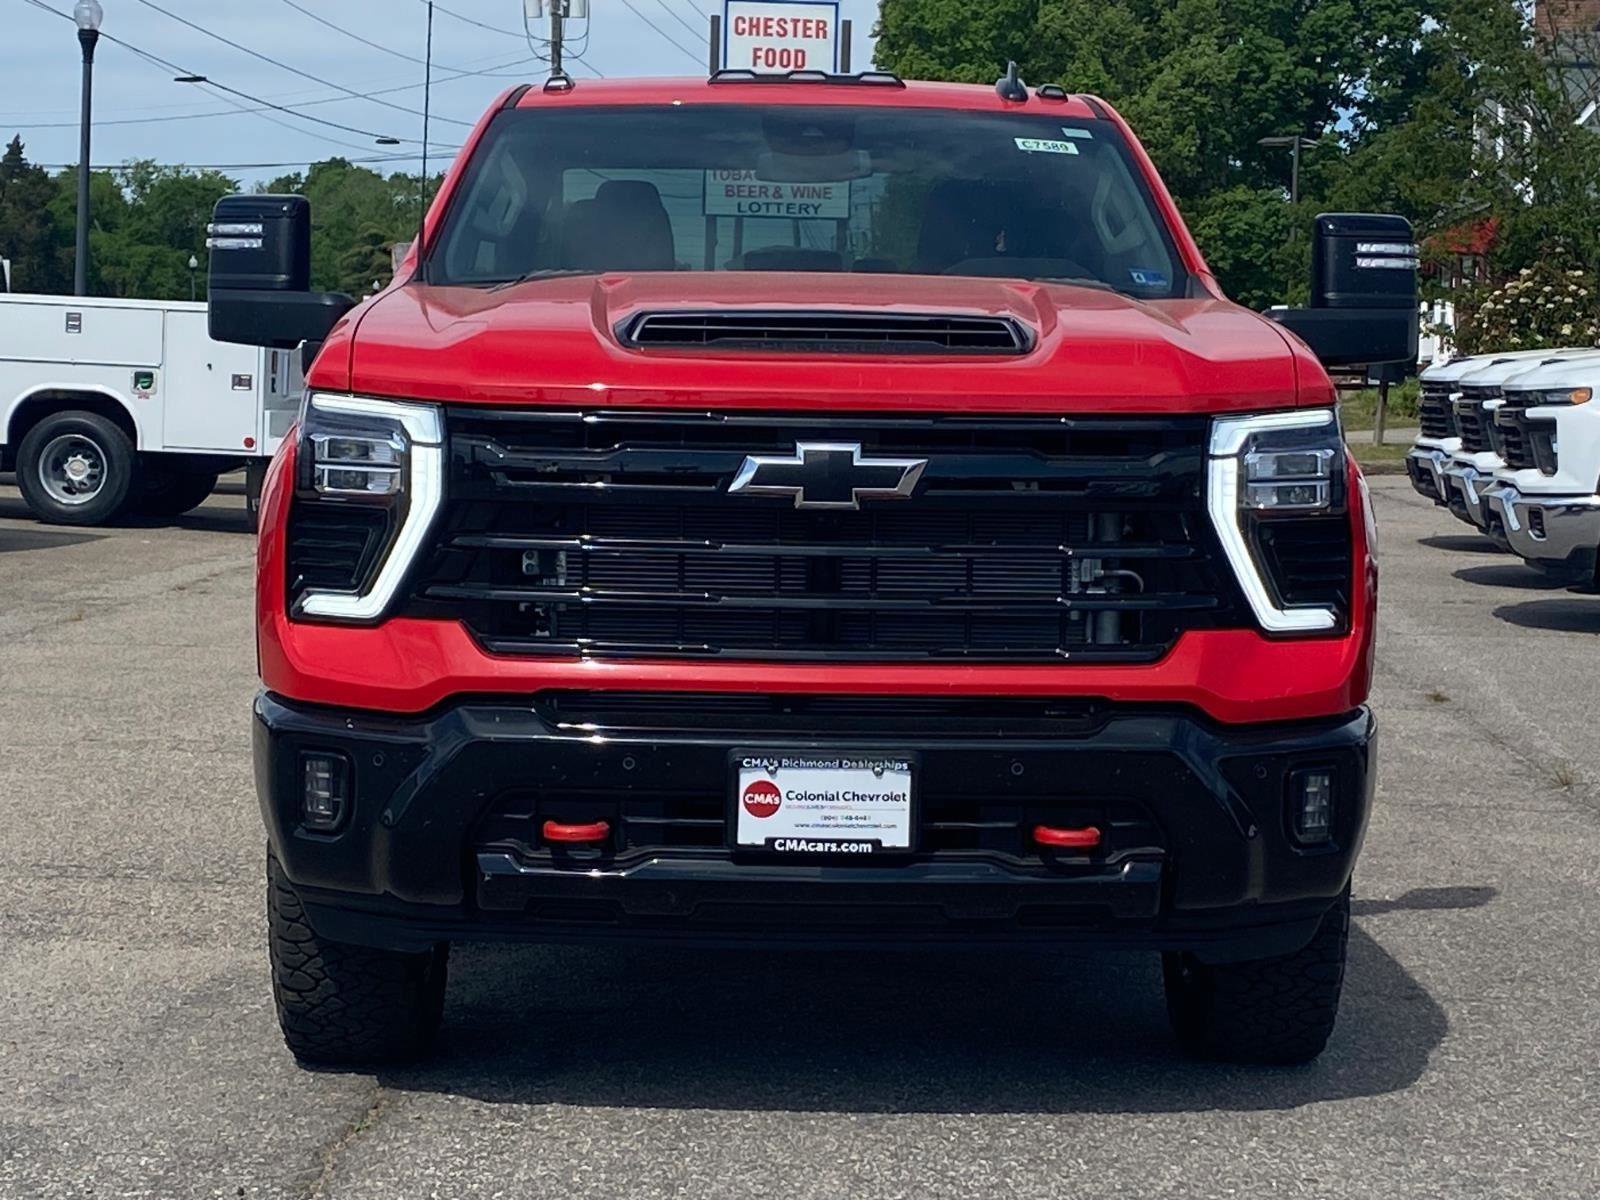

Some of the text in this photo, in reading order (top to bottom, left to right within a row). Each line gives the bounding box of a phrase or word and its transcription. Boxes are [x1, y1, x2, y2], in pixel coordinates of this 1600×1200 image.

[734, 16, 828, 39] CHESTER
[752, 47, 806, 69] FOOD
[711, 170, 757, 181] TOBA
[724, 184, 832, 200] BEER & WINE
[737, 201, 822, 215] LOTTERY
[742, 758, 909, 771] CMA's Richmond Dealerships
[744, 793, 780, 805] CMA's
[785, 790, 907, 803] Colonial Chevrolet
[774, 839, 873, 853] CMAcars.com
